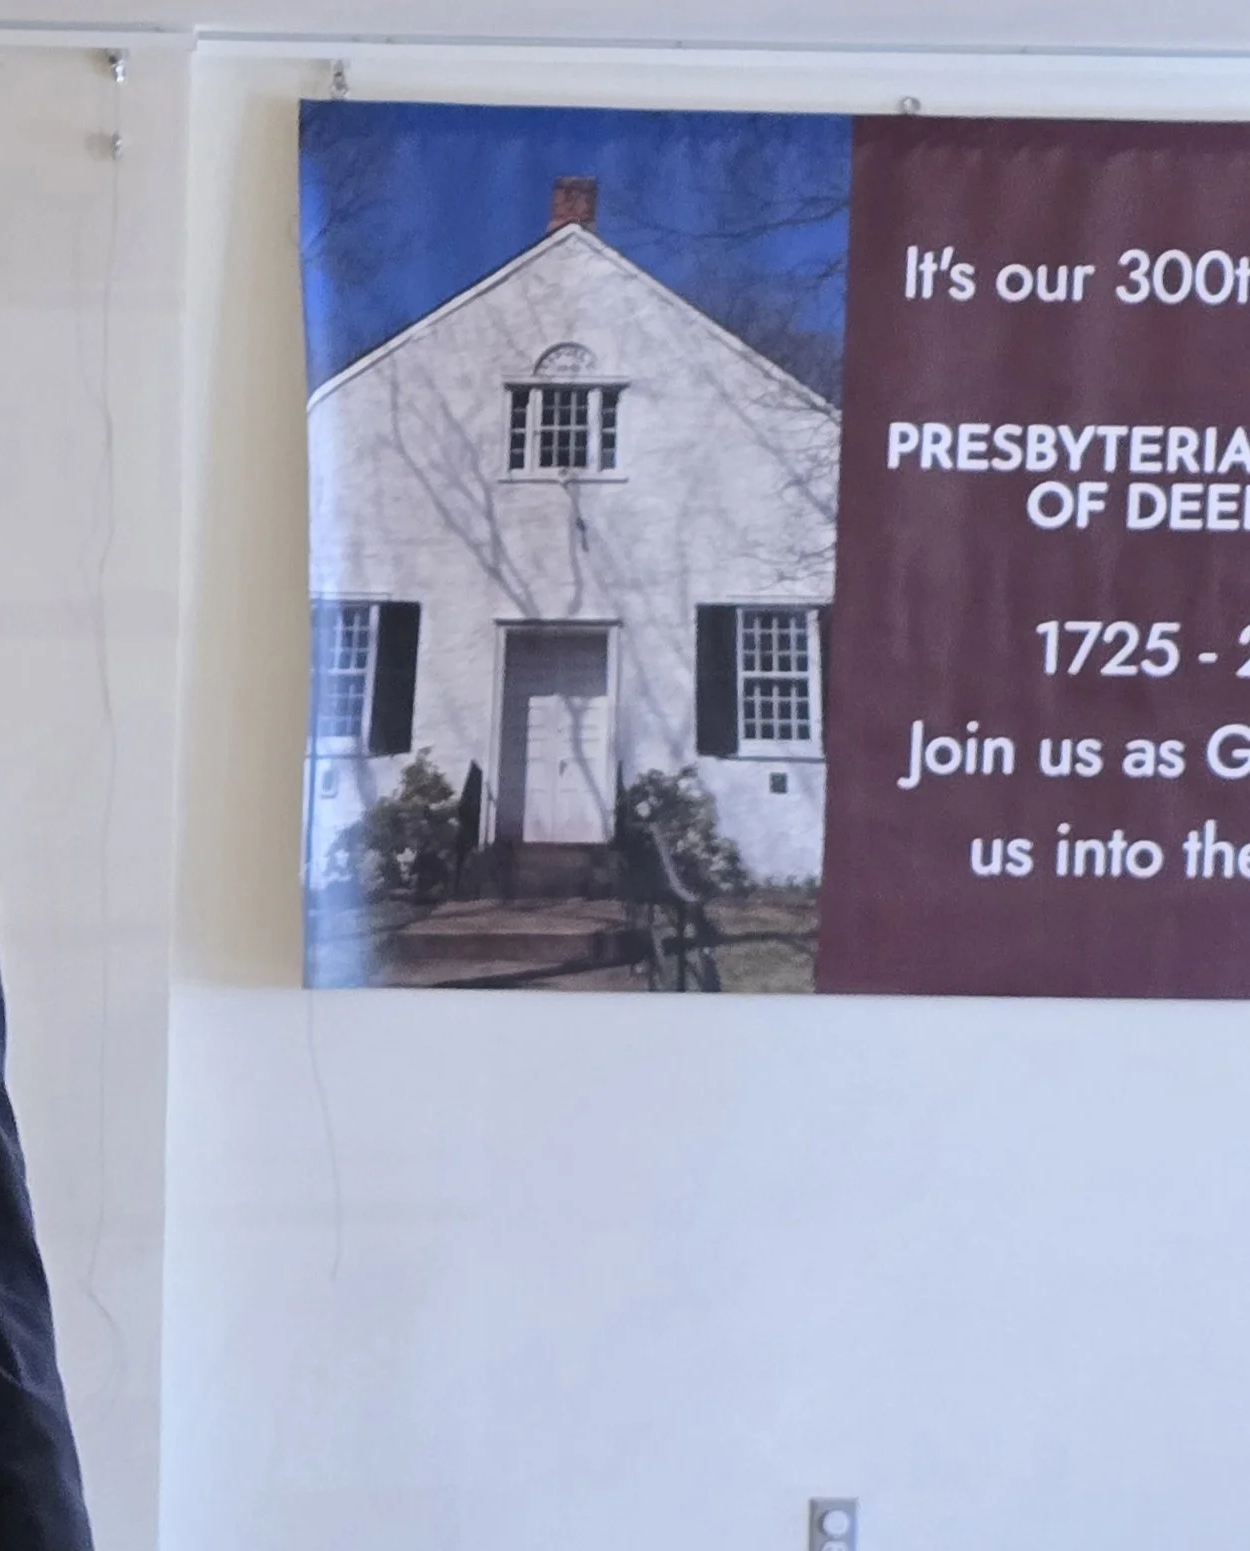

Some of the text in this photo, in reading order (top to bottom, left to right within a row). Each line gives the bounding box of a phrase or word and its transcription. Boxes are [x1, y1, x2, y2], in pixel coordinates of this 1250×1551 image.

[905, 245, 976, 302] It's
[995, 263, 1096, 302] our
[887, 421, 1250, 474] PRESBYTERIA
[1026, 480, 1250, 531] OF DEE
[1036, 620, 1181, 677] 1725
[897, 719, 1015, 790] Join
[1039, 738, 1104, 777] us
[1122, 739, 1186, 778] as
[971, 838, 1034, 877] us
[1056, 822, 1164, 878] into
